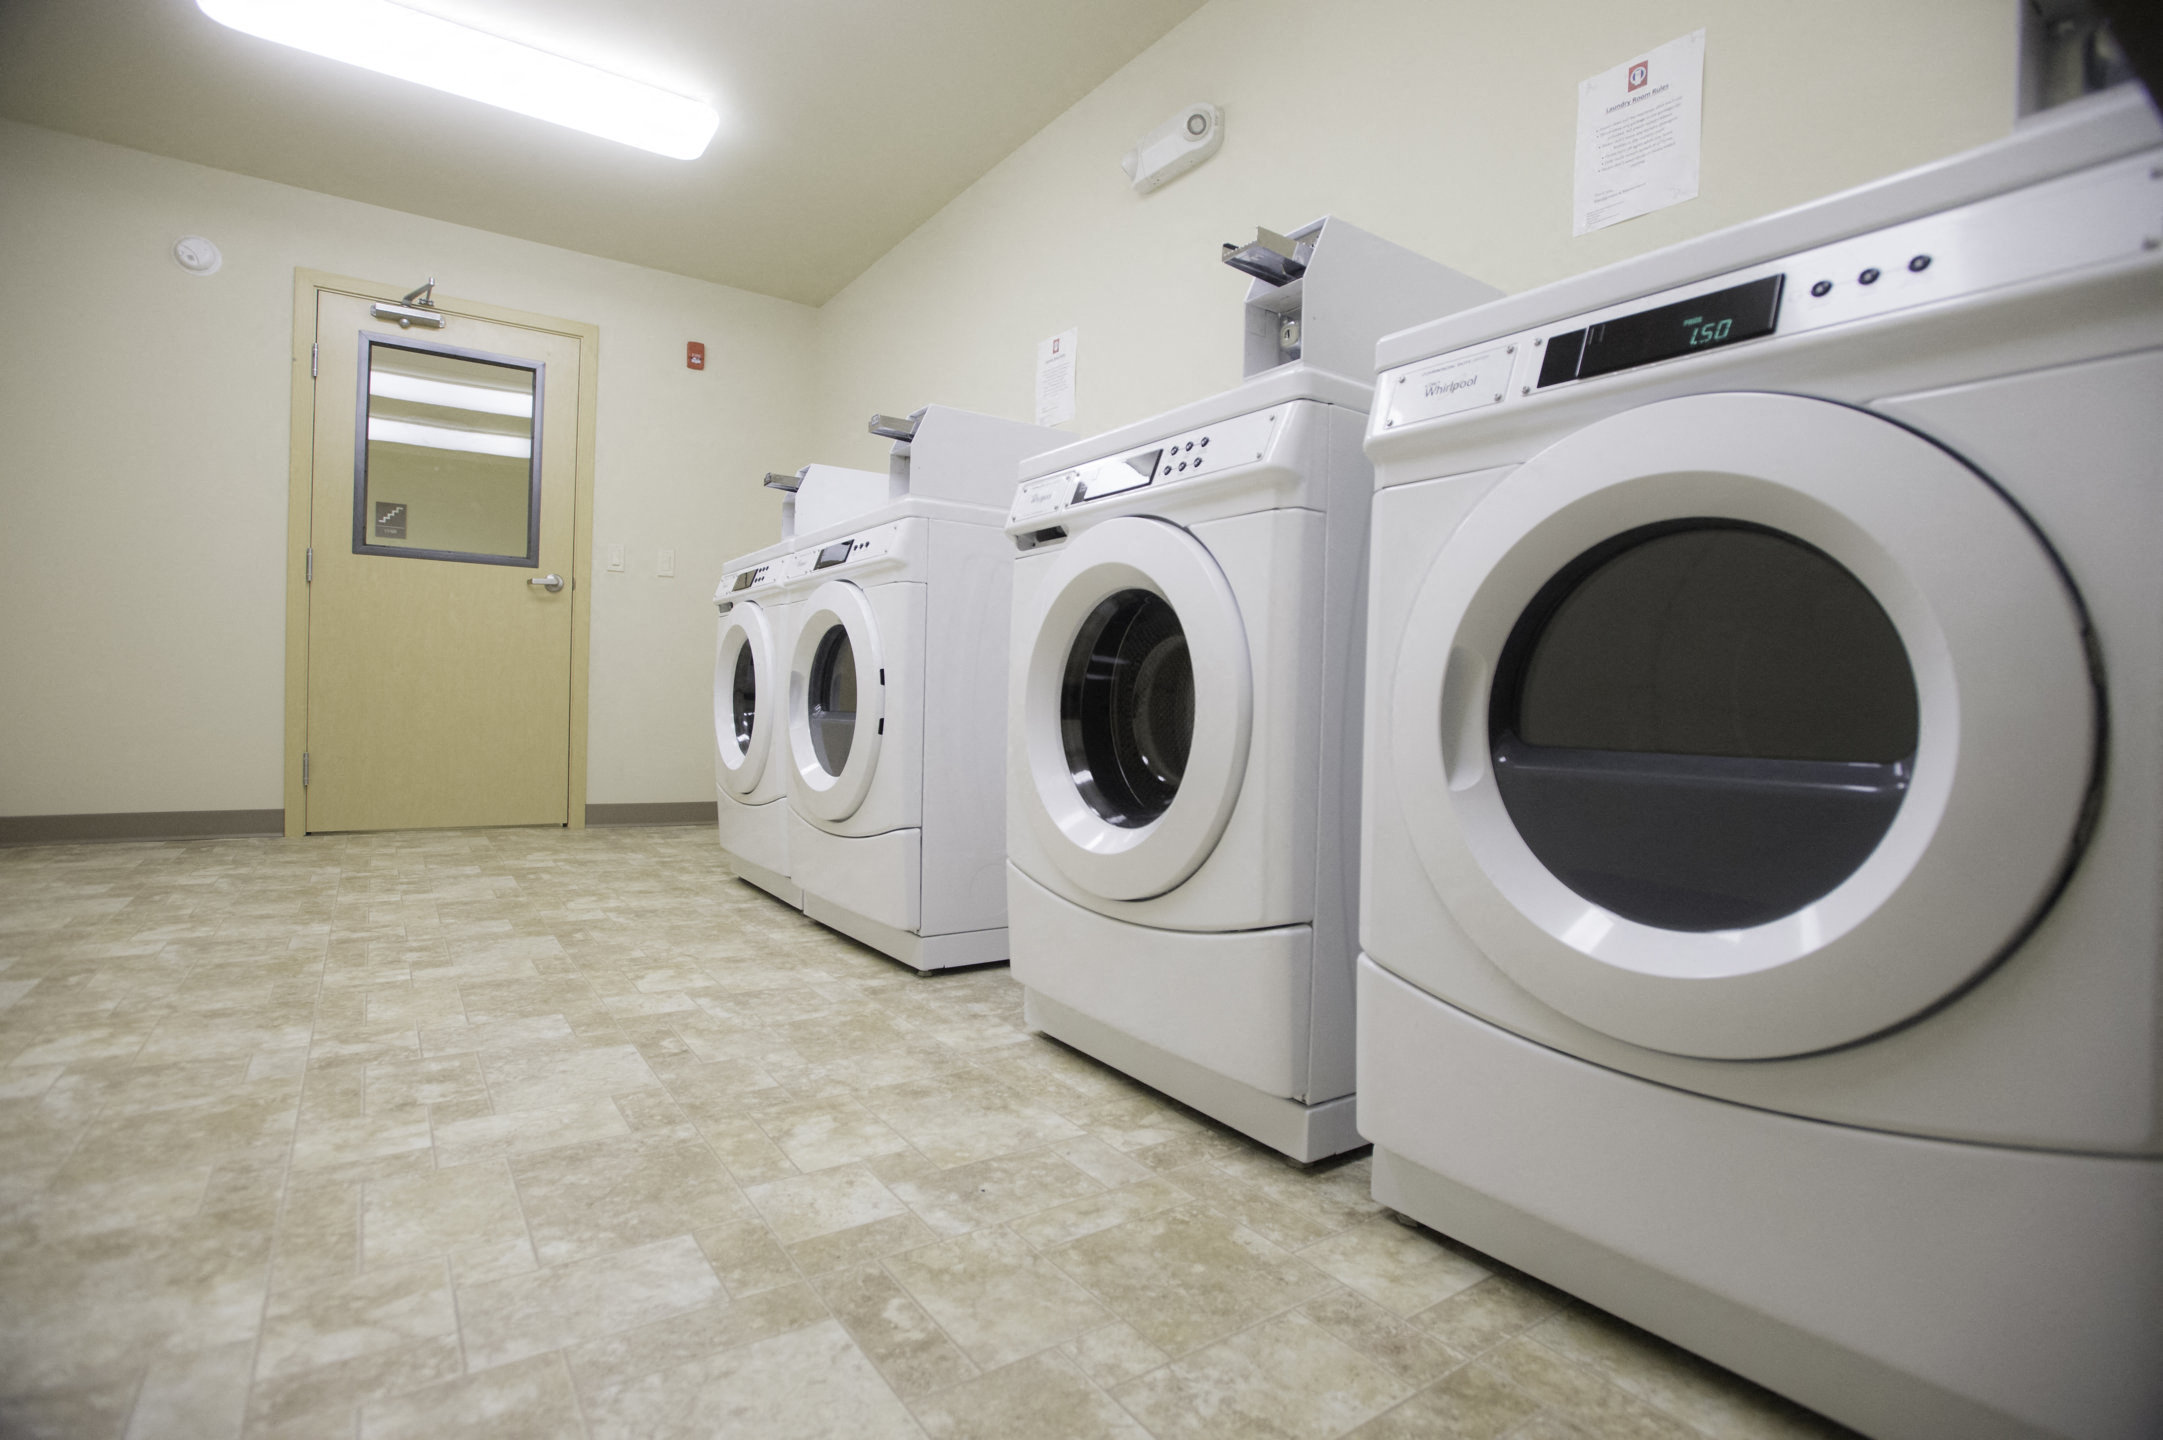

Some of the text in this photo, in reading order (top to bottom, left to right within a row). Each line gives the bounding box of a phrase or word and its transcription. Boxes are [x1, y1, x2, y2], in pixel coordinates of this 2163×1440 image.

[1606, 84, 1669, 115] Laundry Room Rules
[1425, 375, 1478, 398] Whirlpool
